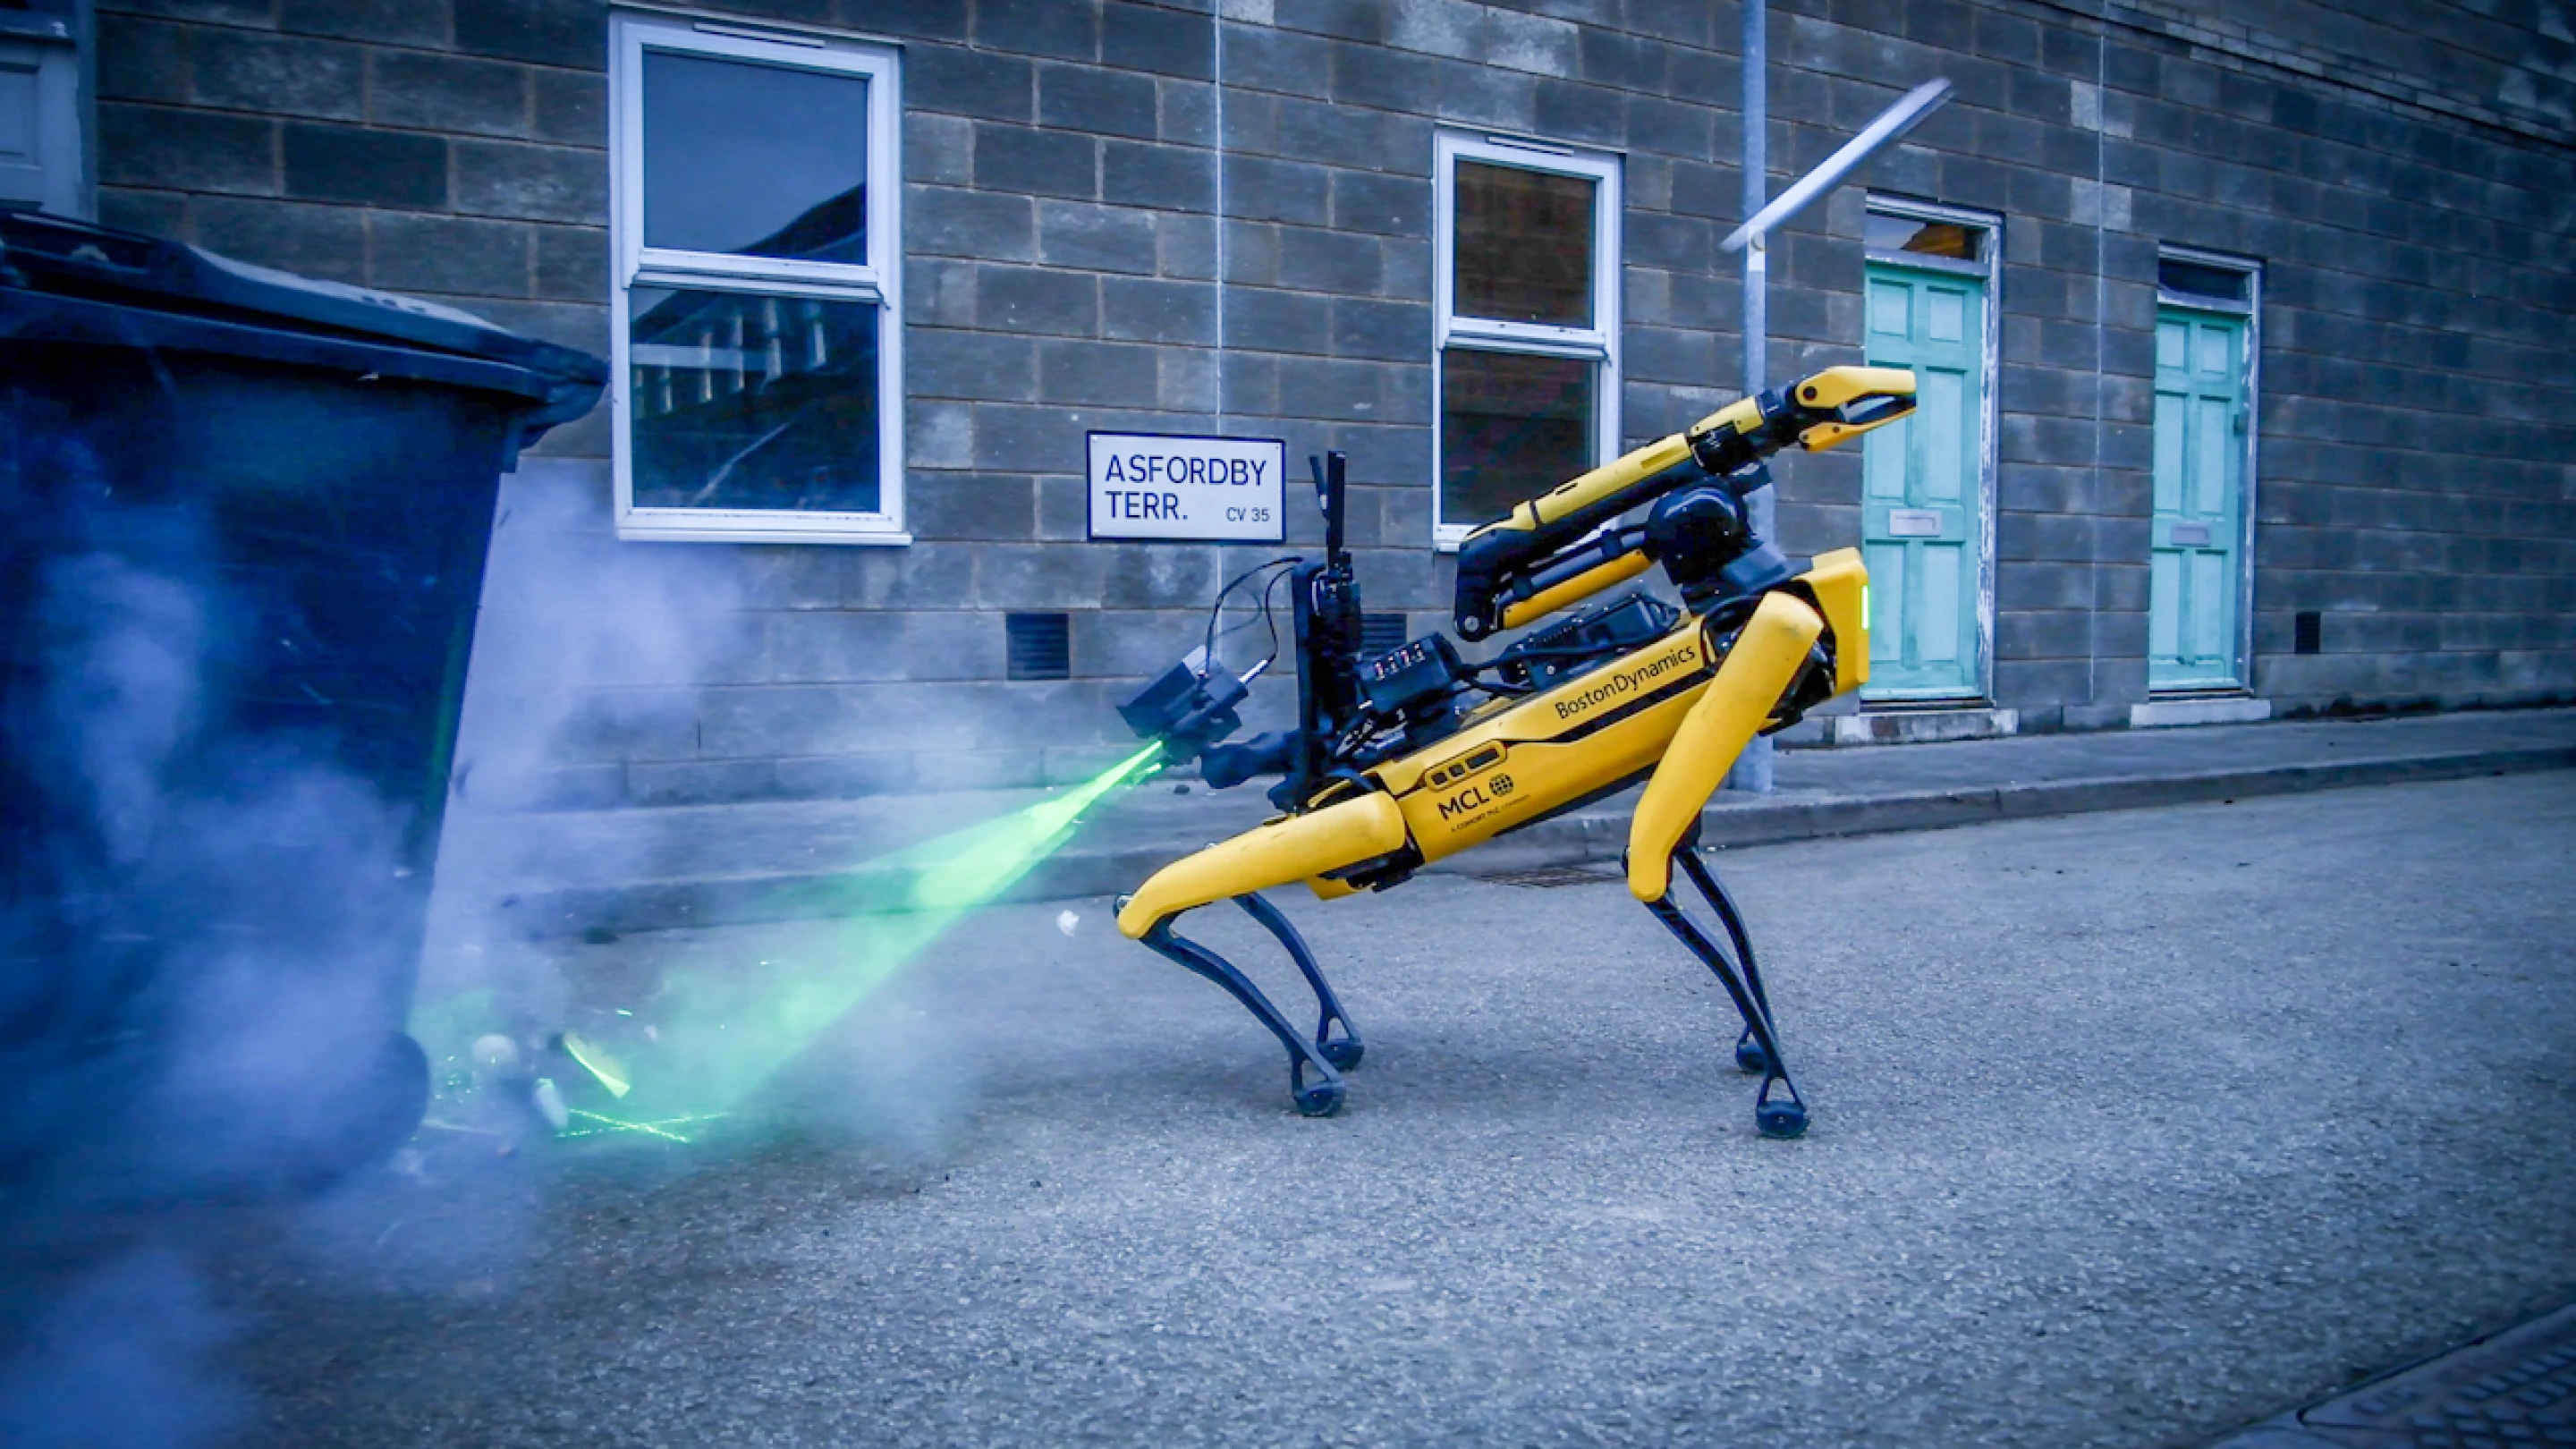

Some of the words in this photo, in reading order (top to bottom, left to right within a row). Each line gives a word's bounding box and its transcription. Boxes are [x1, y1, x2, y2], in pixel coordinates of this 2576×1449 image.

[1105, 454, 1267, 487] ASFORDBY
[1105, 490, 1189, 521] TERR.
[1225, 506, 1247, 522] CV
[1251, 507, 1271, 522] 35
[1436, 786, 1490, 821] MCL
